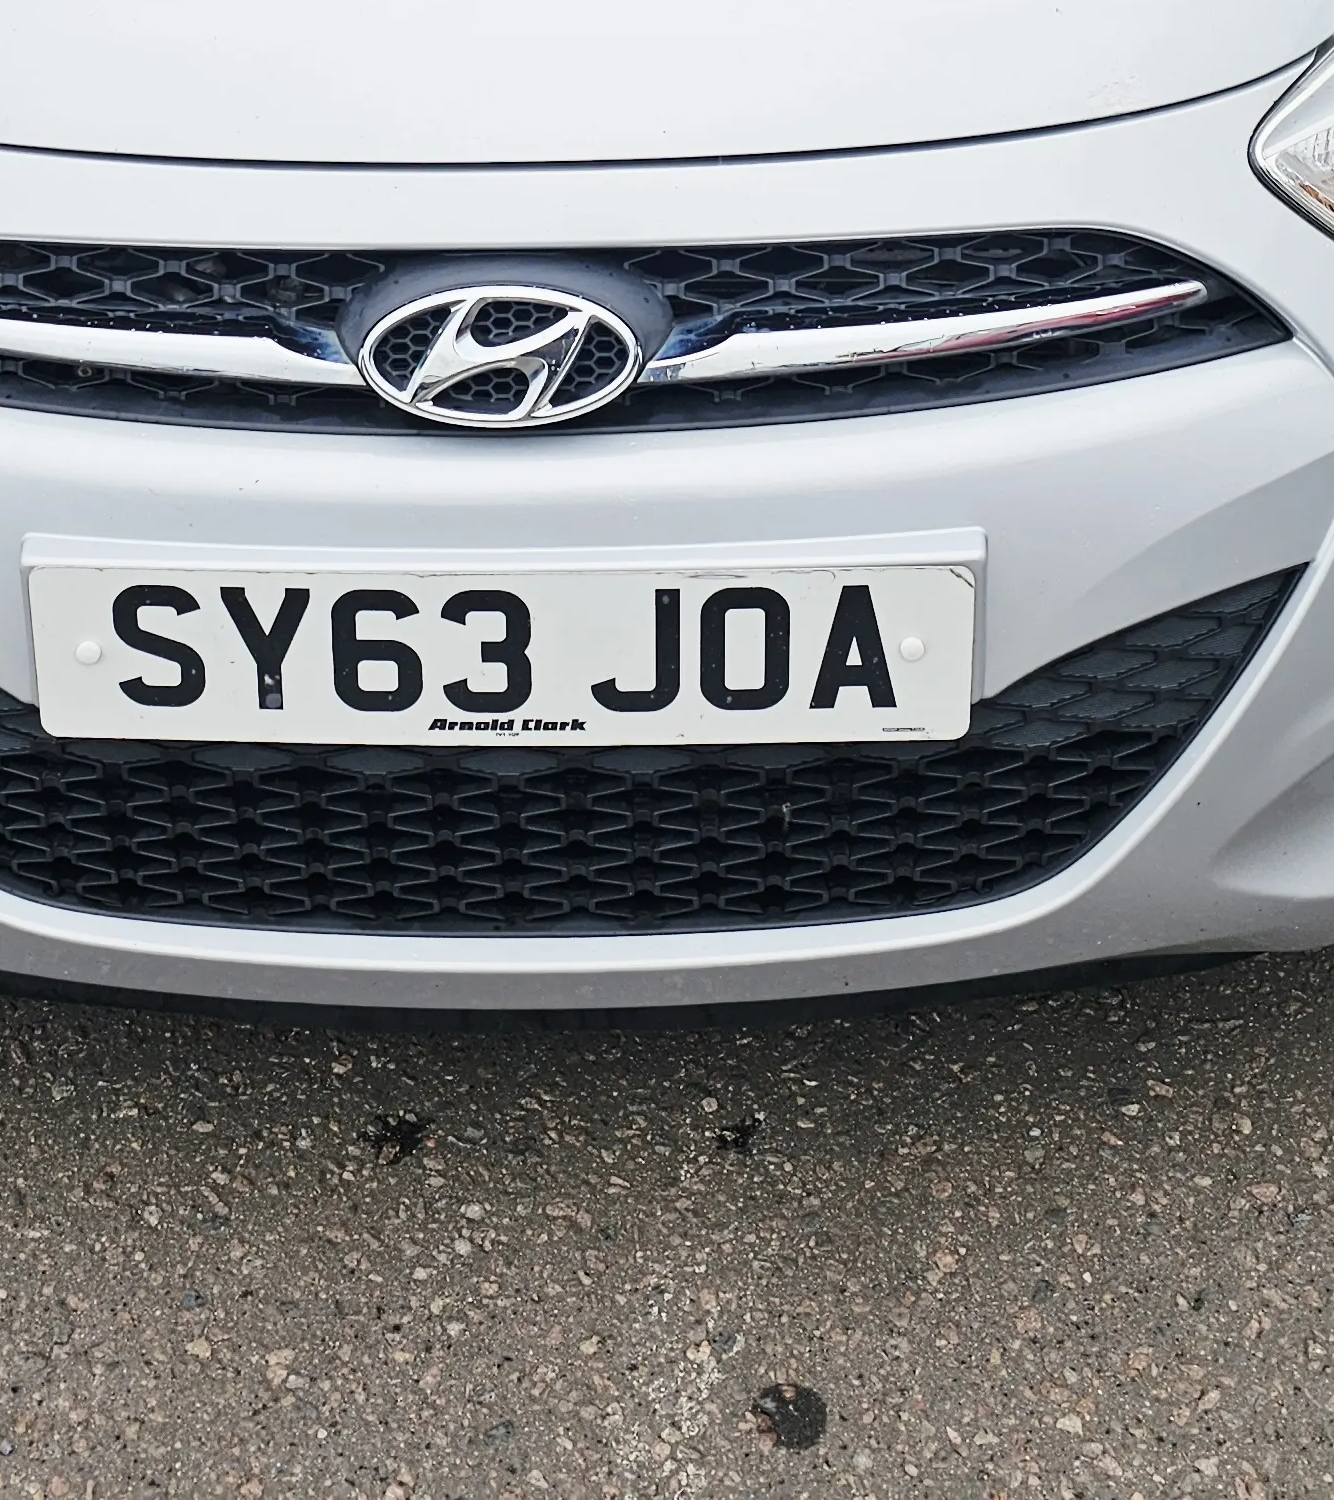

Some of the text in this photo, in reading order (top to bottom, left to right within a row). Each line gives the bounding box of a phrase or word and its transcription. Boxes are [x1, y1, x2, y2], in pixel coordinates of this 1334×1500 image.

[111, 583, 899, 714] SY63 JOA
[427, 718, 588, 732] Arnold Clark
